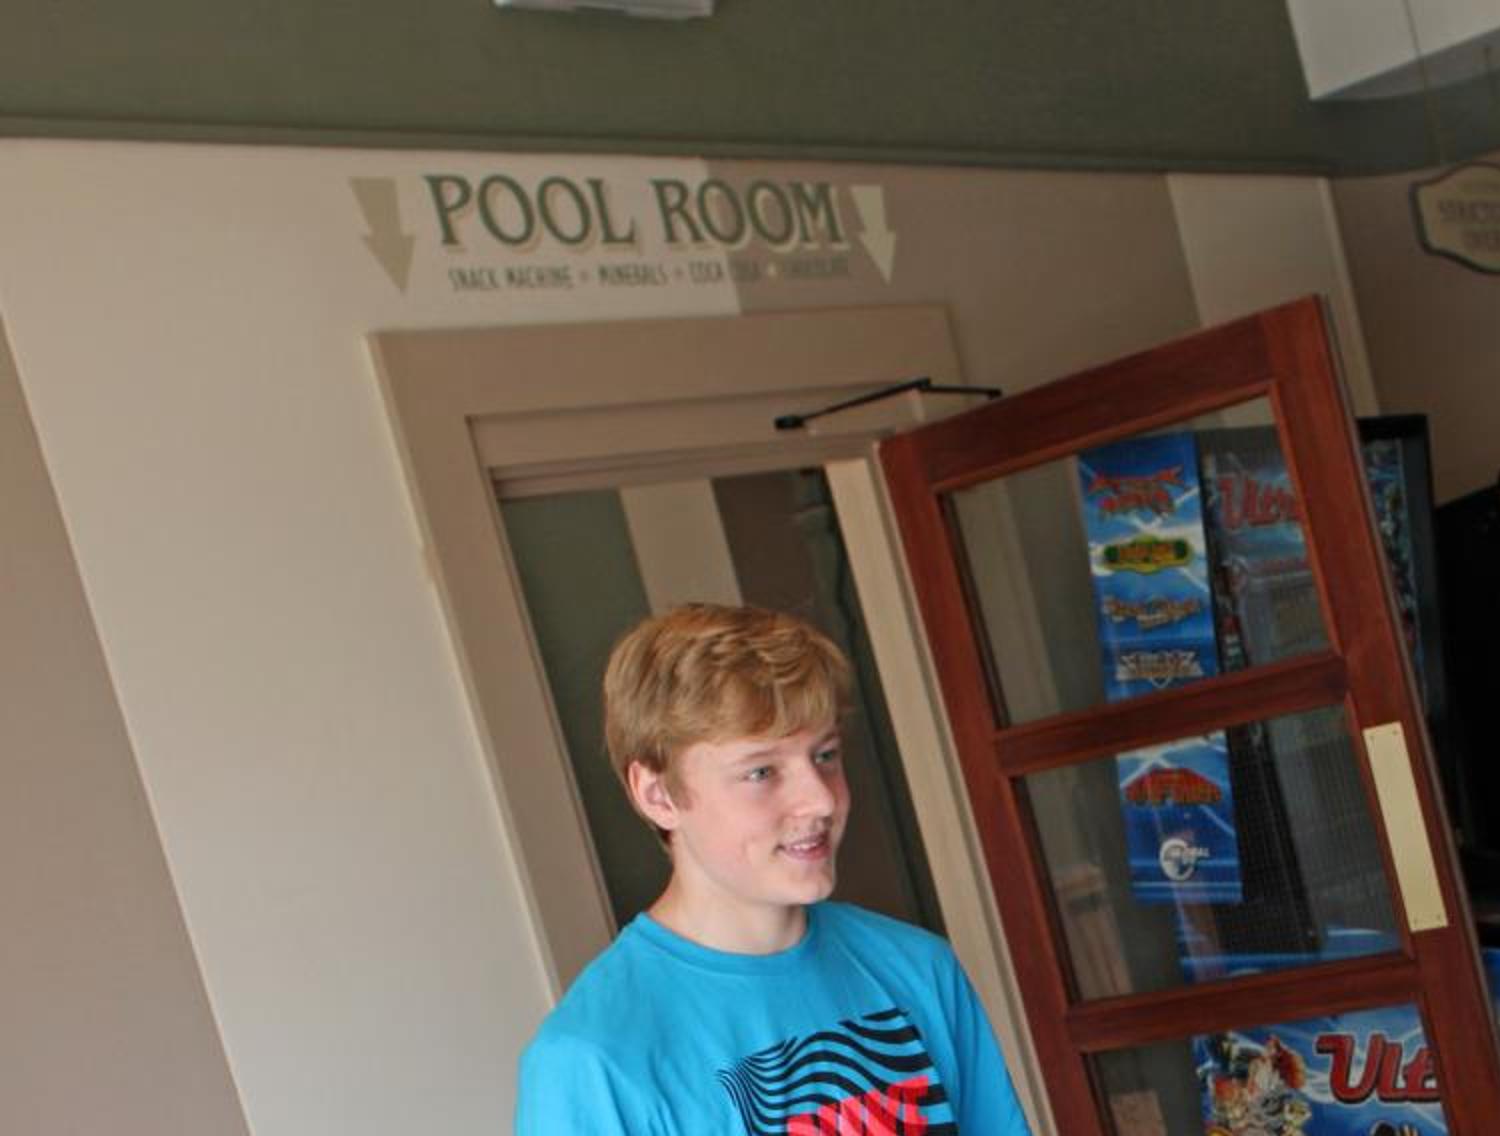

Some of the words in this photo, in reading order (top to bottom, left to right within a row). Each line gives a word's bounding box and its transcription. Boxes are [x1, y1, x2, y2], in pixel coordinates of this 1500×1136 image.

[422, 173, 637, 247] POOL
[649, 178, 848, 249] ROOM
[447, 265, 501, 291] SNACK
[504, 264, 574, 290] MACHINE
[598, 262, 670, 287] MINERALS
